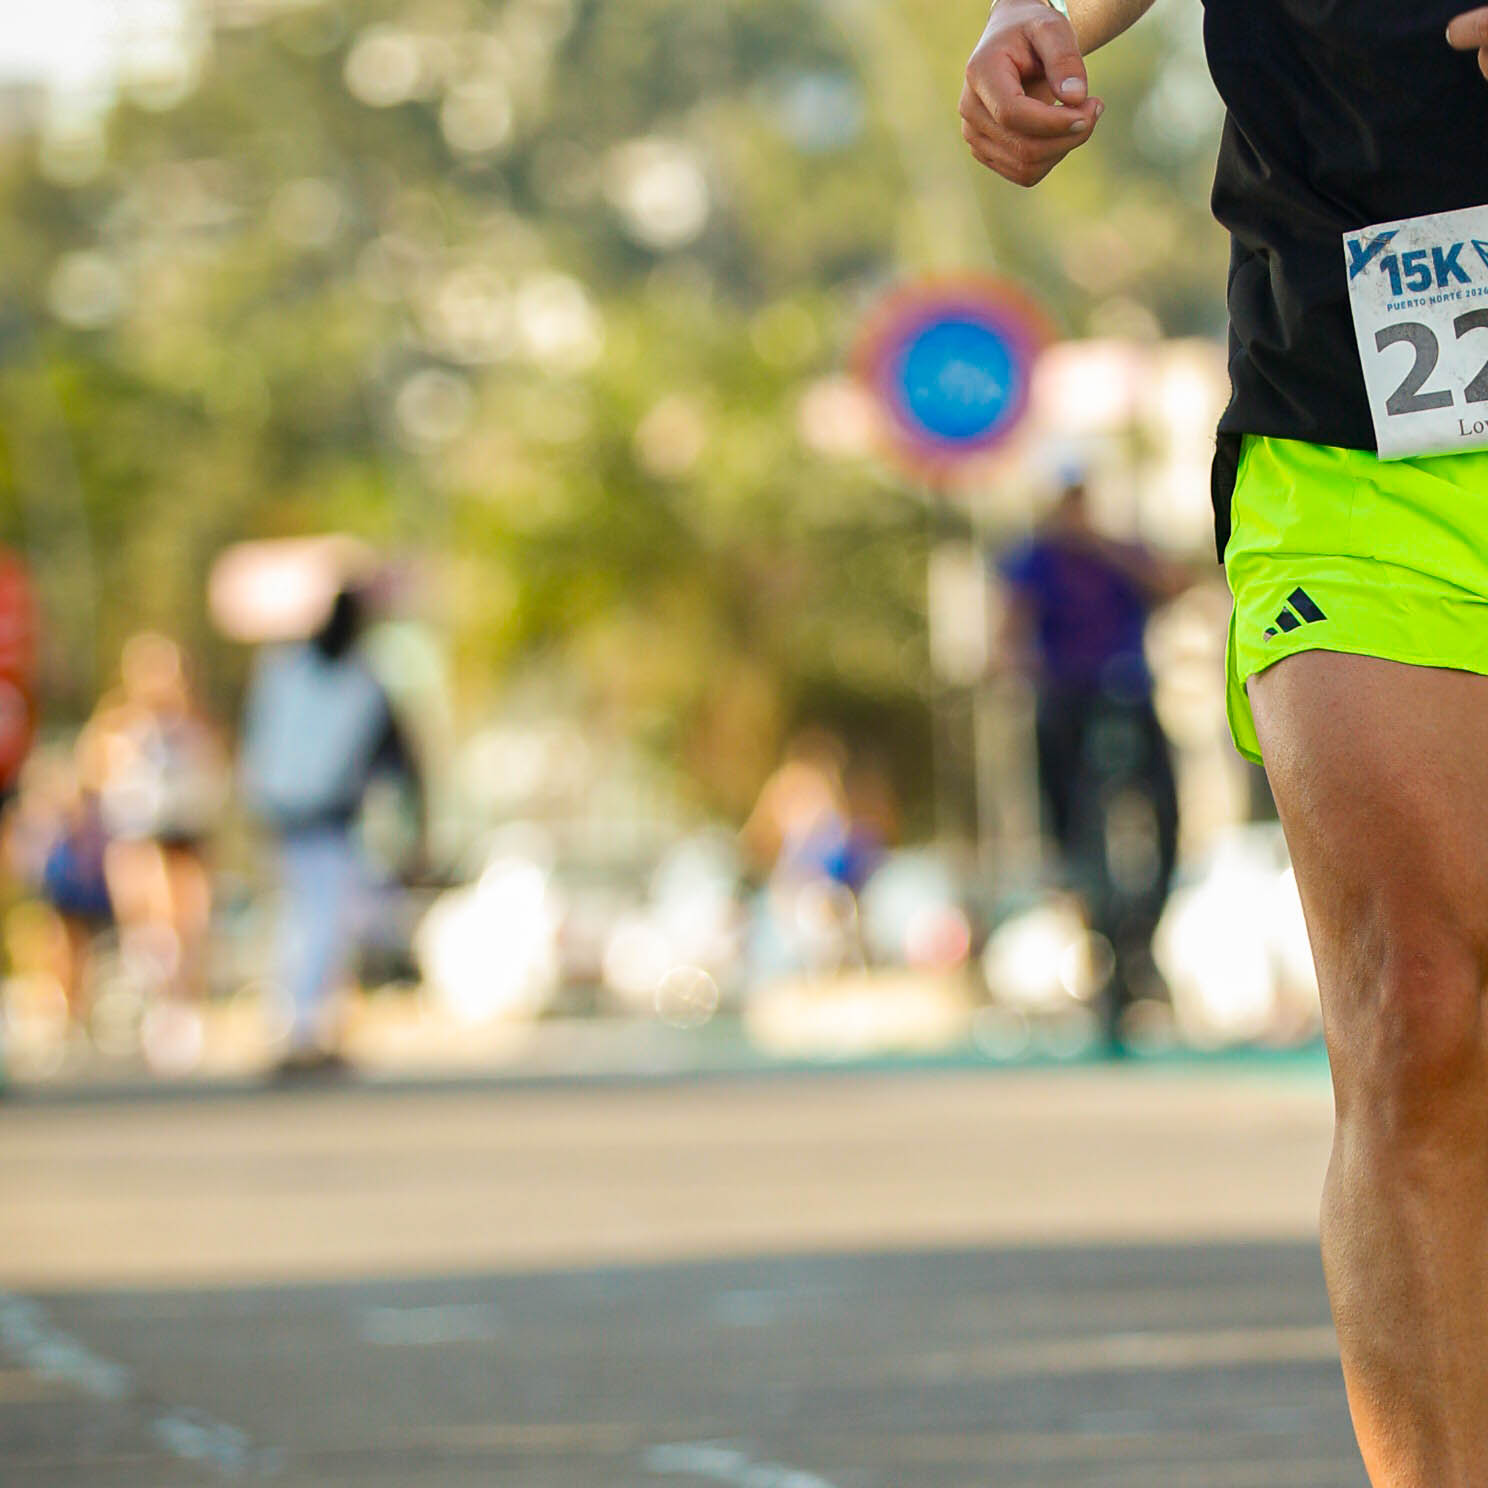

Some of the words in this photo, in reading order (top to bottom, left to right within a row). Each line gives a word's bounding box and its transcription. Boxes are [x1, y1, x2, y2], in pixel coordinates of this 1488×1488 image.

[1380, 241, 1472, 296] 15K
[1386, 298, 1426, 312] PUERTO
[1429, 291, 1462, 305] NORTE
[1465, 287, 1488, 298] 2026
